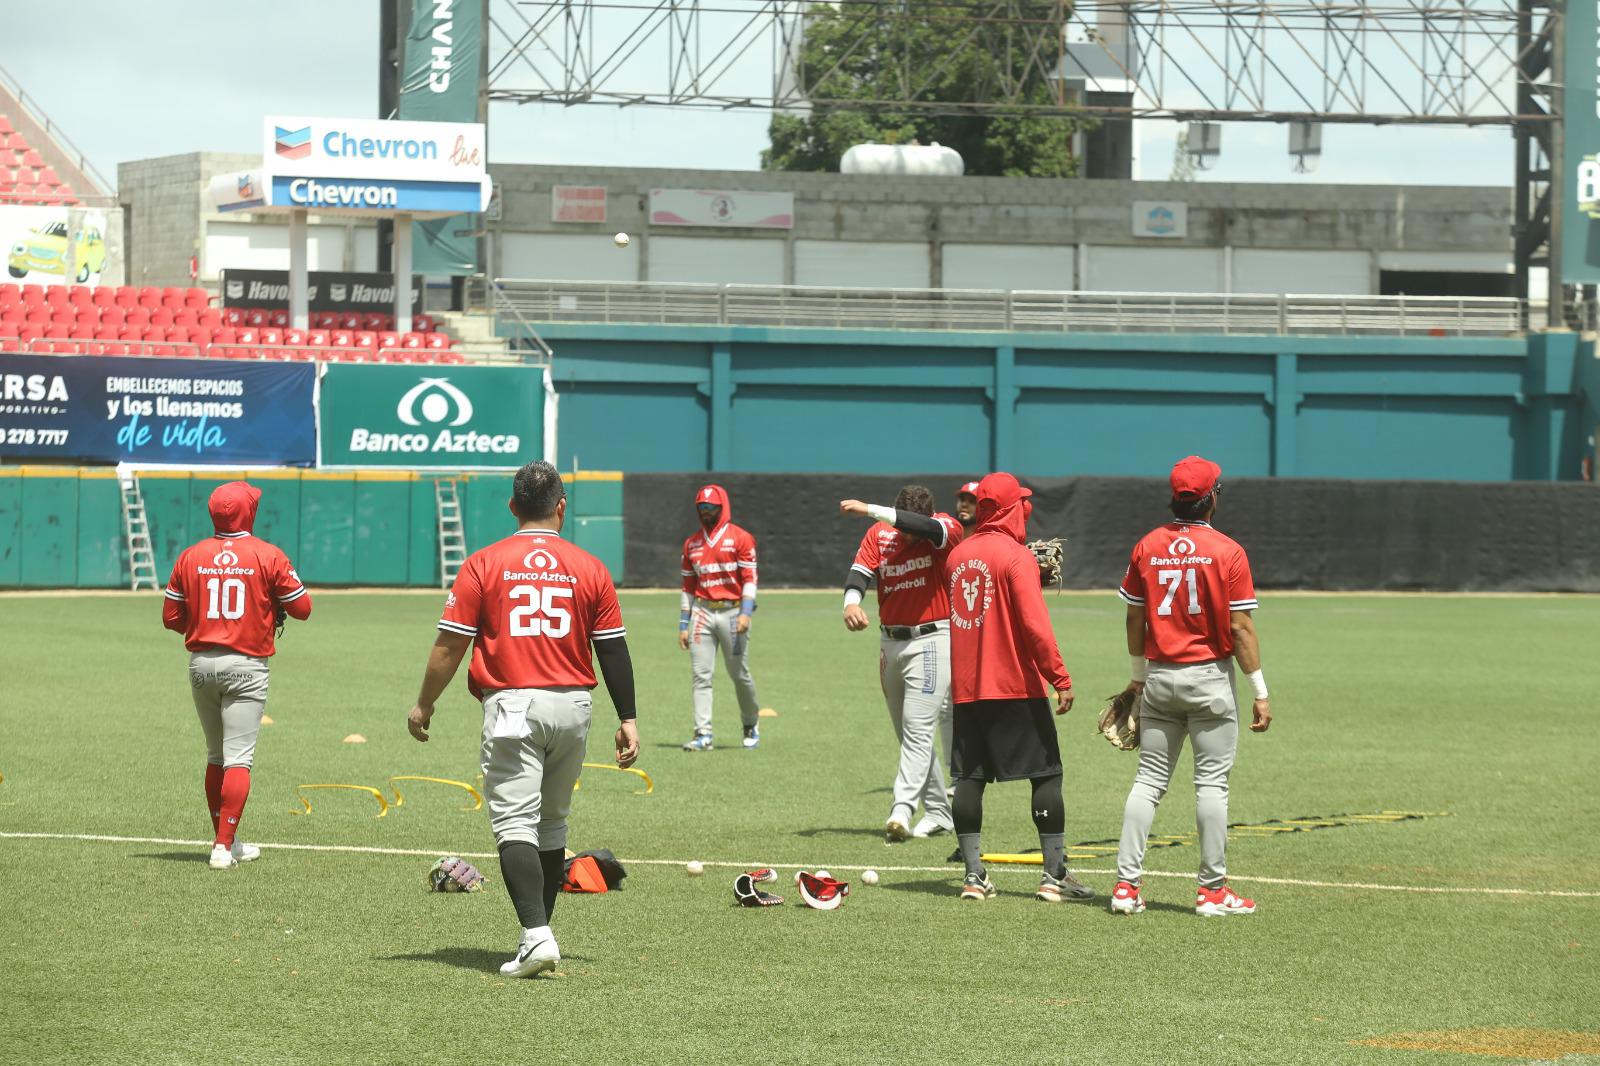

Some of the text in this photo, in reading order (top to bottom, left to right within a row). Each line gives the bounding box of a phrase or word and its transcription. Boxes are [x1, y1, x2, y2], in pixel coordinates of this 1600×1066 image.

[322, 131, 438, 160] Chevron
[289, 178, 398, 205] Chevron
[248, 281, 318, 301] Havoe
[350, 284, 419, 304] Havole
[0, 374, 70, 401] RSA
[106, 376, 244, 396] EMBELLECEMOS ESPACIOS
[106, 395, 243, 420] y los llenamos
[7, 428, 36, 445] 278
[37, 429, 69, 446] 7717
[116, 410, 227, 454] de vida
[349, 428, 520, 453] Banco Azteca
[197, 566, 255, 576] Banco Azteca
[1150, 555, 1213, 566] Banco Azteca
[503, 570, 577, 585] Banco Azteca
[207, 578, 246, 620] 10
[1157, 568, 1201, 616] 71
[509, 585, 573, 638] 25
